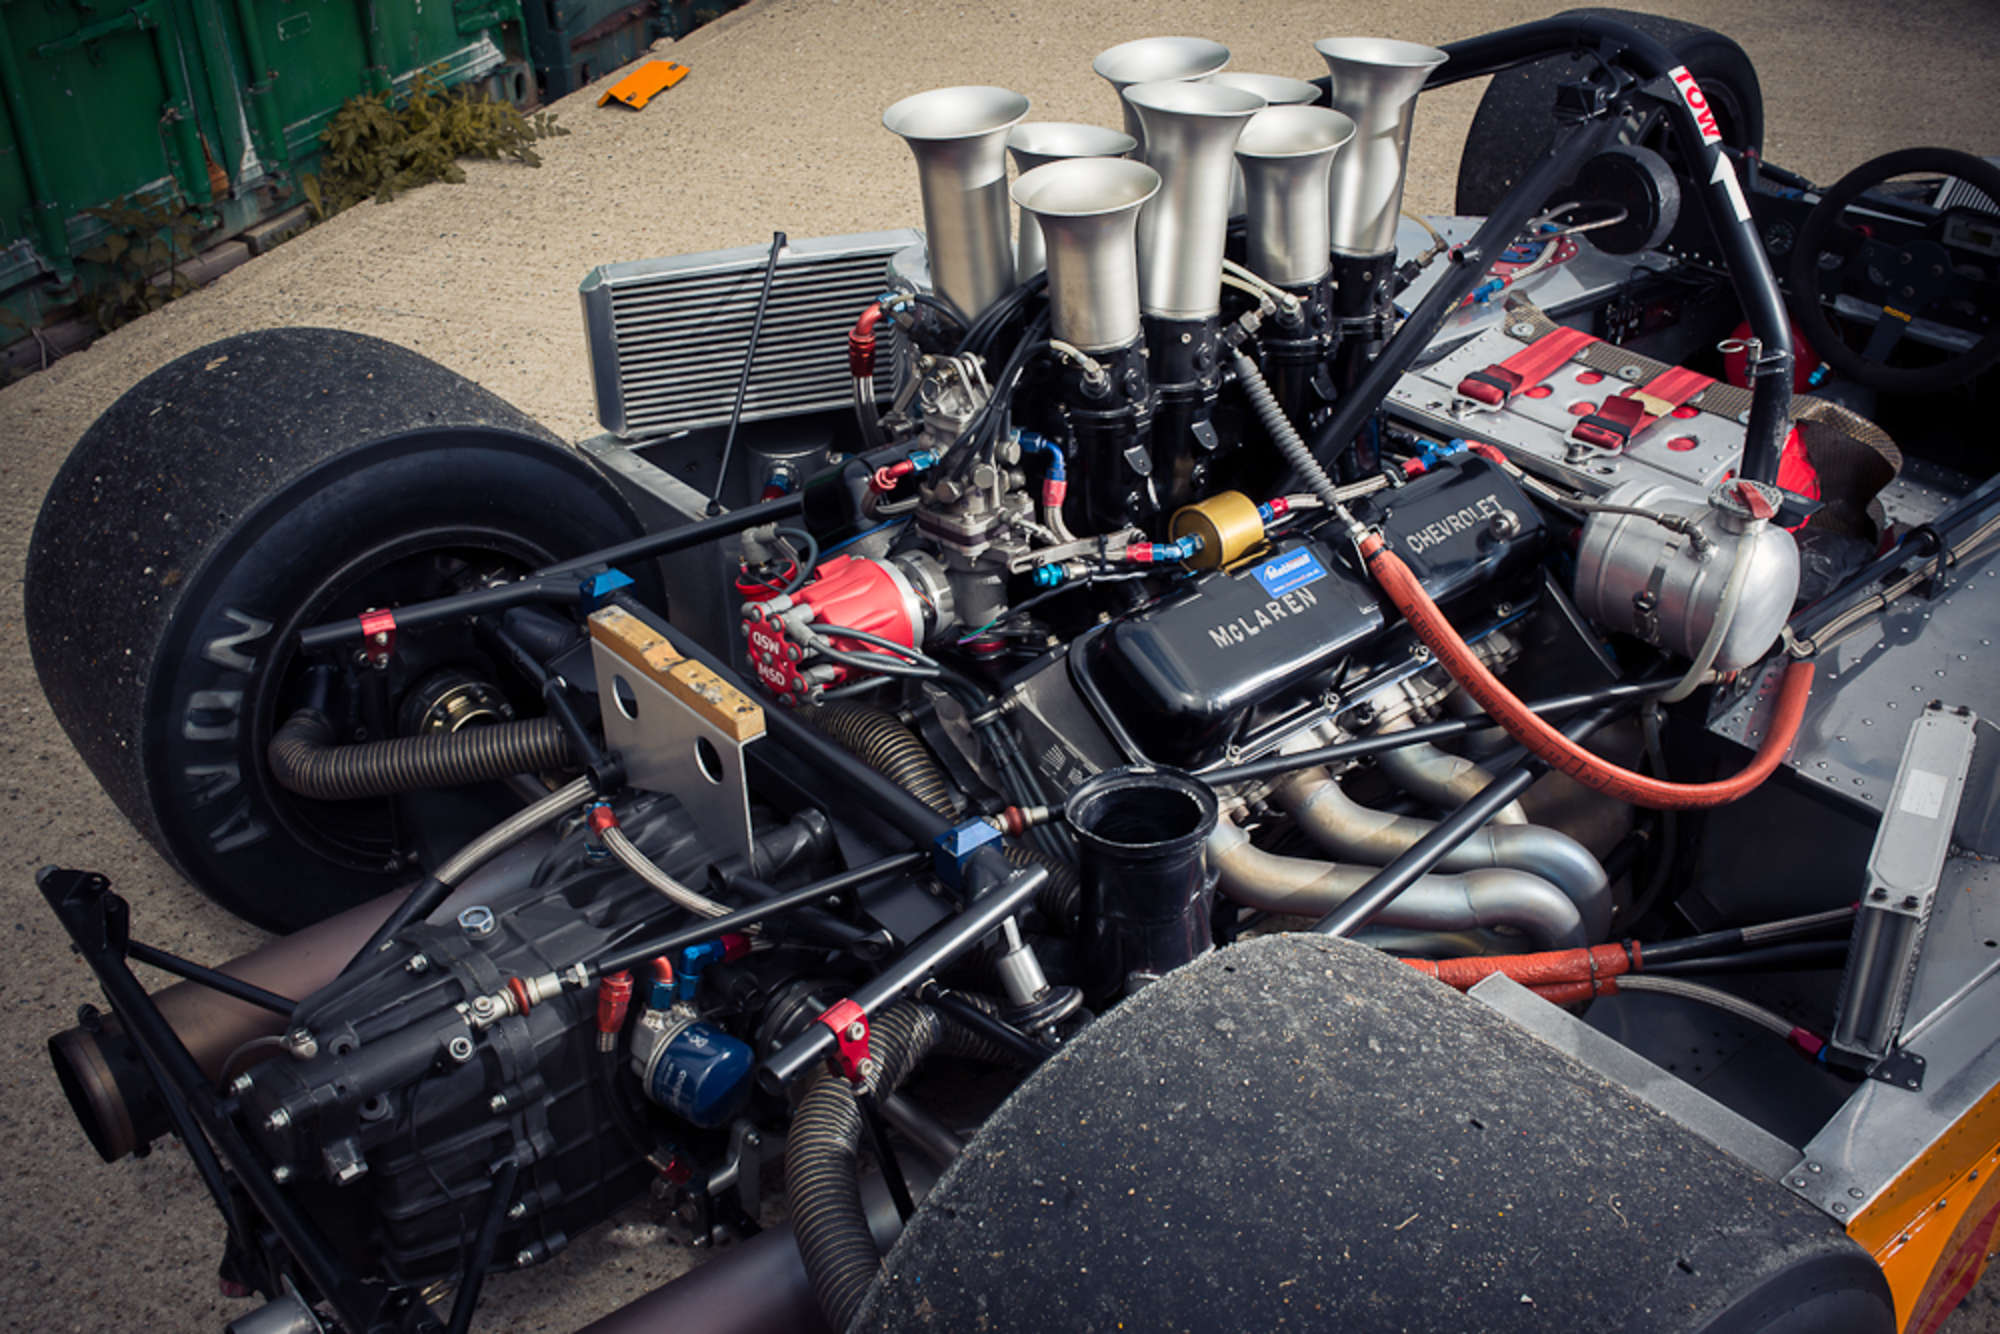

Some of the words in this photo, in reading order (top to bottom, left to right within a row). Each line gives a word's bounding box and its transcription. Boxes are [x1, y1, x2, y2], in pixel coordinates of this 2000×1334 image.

[1675, 65, 1721, 137] TOW
[1406, 494, 1504, 555] CHEVROLET
[752, 631, 780, 655] MSD
[1208, 586, 1318, 649] McLAREN
[758, 662, 785, 687] MSD
[183, 607, 273, 852] AVON
